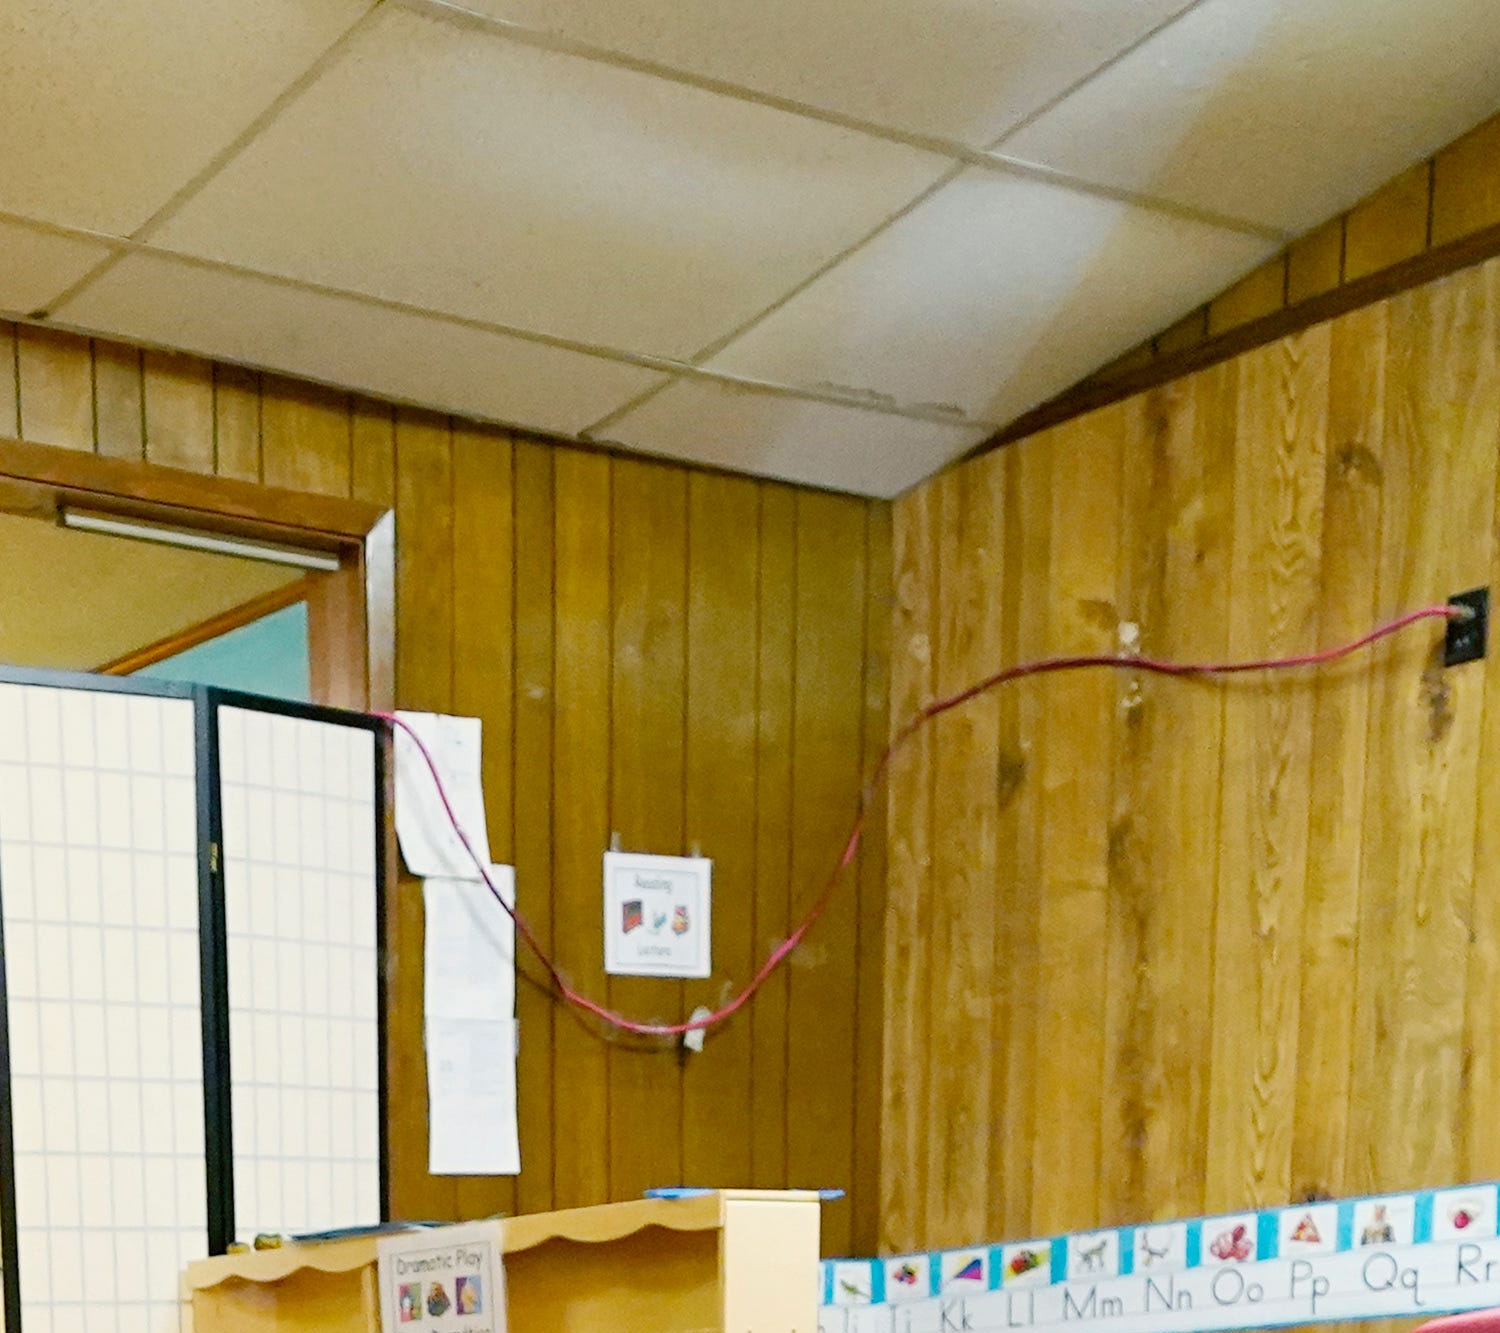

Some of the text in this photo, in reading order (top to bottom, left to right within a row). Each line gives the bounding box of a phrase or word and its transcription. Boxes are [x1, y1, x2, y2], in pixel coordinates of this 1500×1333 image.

[397, 1249, 482, 1275] Dramatic Play
[940, 1296, 974, 1333] Kk
[1063, 1285, 1124, 1321] Mm
[1145, 1274, 1192, 1312] Nn
[1211, 1267, 1264, 1305] Oo
[1290, 1260, 1330, 1314] Pp
[1362, 1252, 1425, 1306] Qq
[1456, 1243, 1498, 1285] Rr
